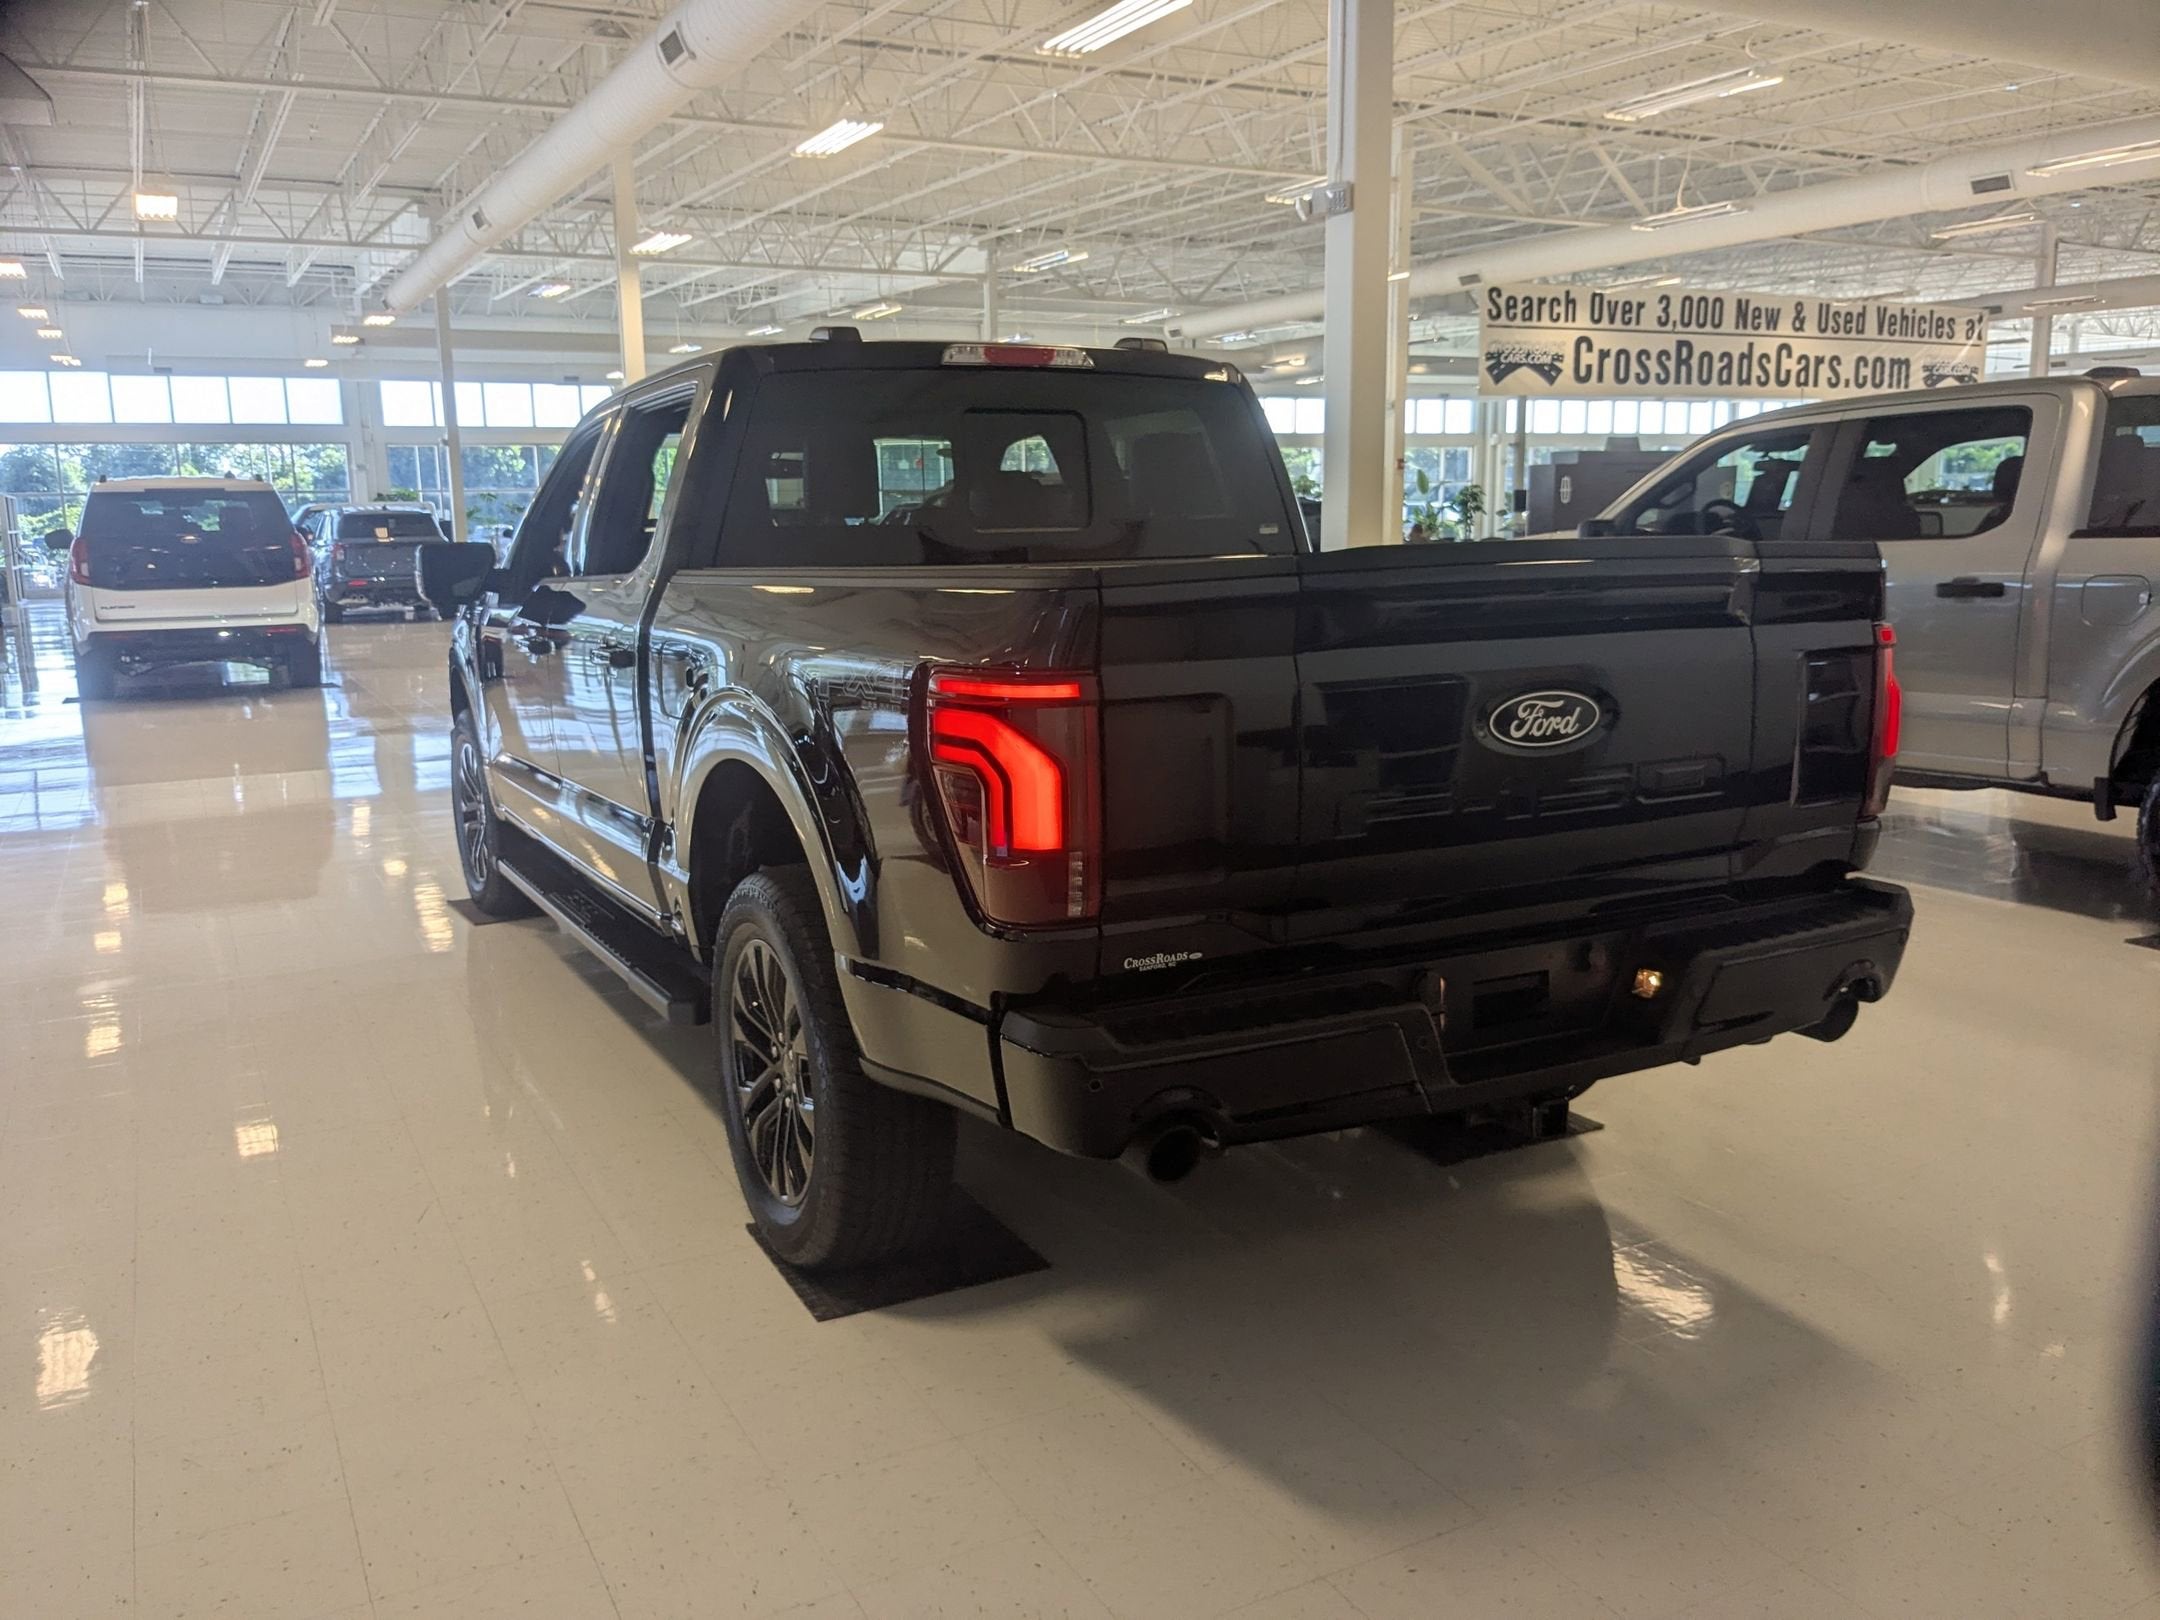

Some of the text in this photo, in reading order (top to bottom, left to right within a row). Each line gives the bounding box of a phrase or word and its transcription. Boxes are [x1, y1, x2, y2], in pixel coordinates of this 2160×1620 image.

[1487, 286, 1984, 341] Search Over 3,000 New & Used Vehicles at
[1500, 353, 1553, 365] CARS.COM
[1573, 336, 1911, 389] CrossRoadsCars.com
[1509, 699, 1582, 739] Ford
